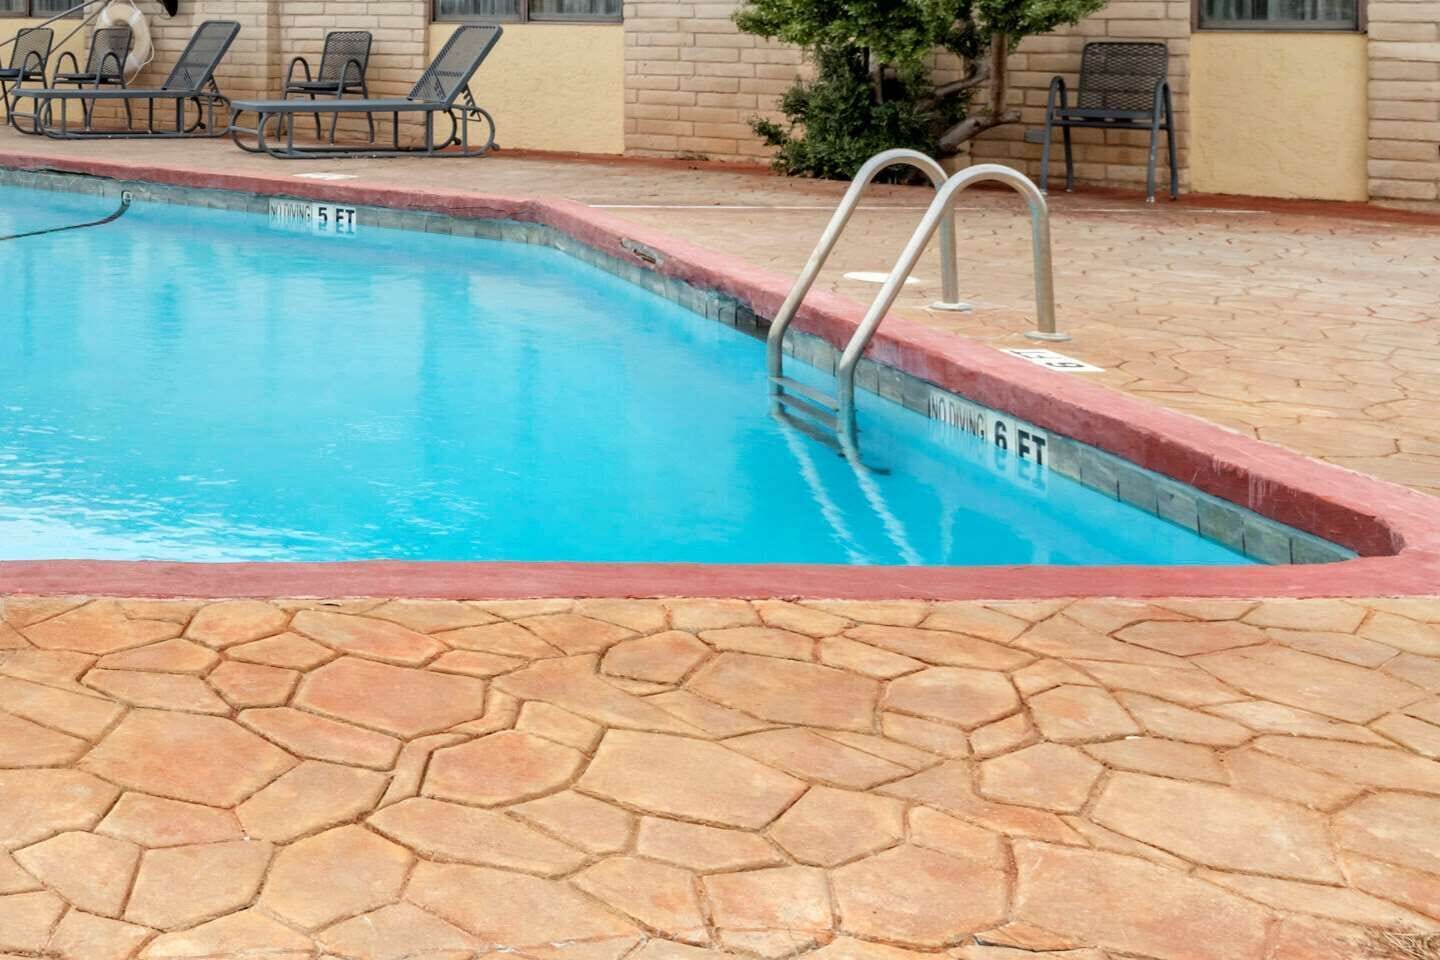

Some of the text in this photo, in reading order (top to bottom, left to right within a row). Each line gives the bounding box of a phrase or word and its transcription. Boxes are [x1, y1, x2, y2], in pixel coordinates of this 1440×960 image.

[318, 206, 328, 222] 5
[336, 208, 355, 224] FT
[932, 395, 1046, 465] NO DIVING 6 FT
